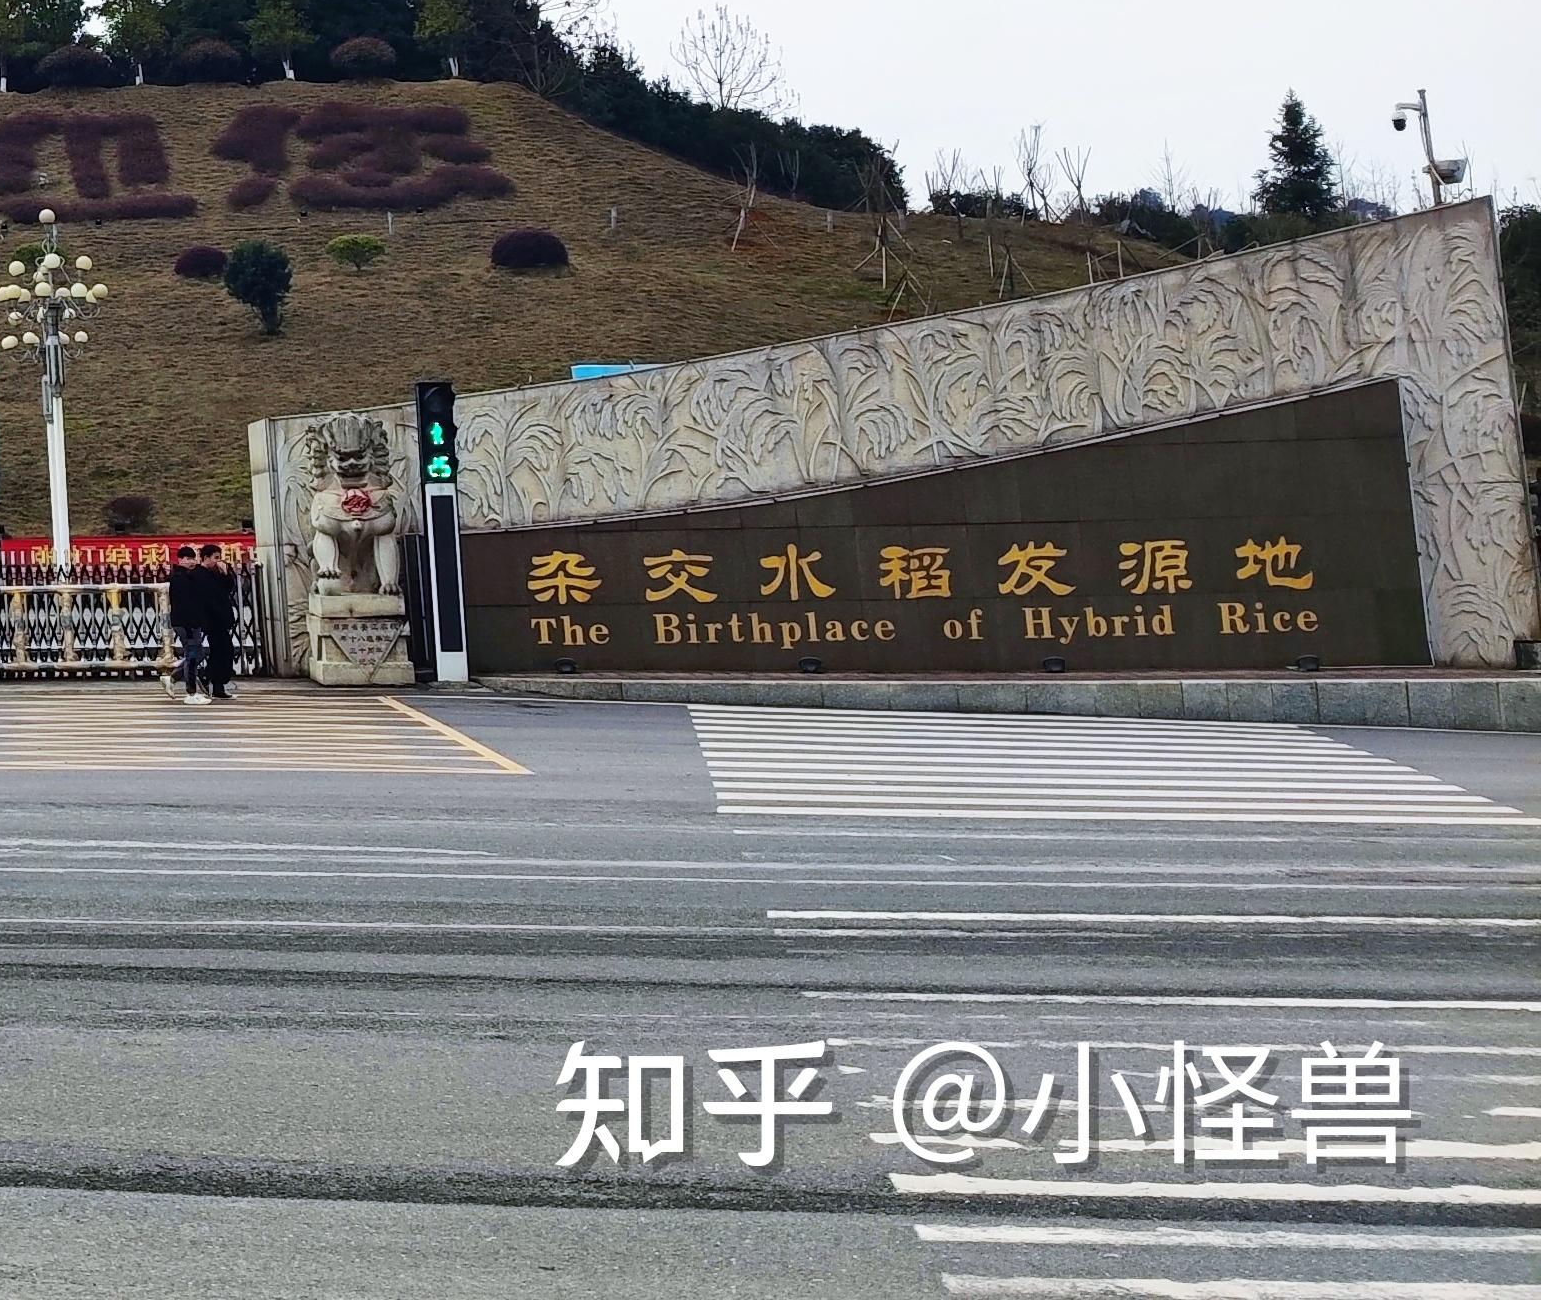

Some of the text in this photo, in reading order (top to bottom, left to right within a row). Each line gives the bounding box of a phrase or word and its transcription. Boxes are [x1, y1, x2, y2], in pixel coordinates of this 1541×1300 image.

[525, 533, 1315, 605] 杂交水稻发源地
[530, 600, 1320, 650] The Birthplace of Hybrid Rice
